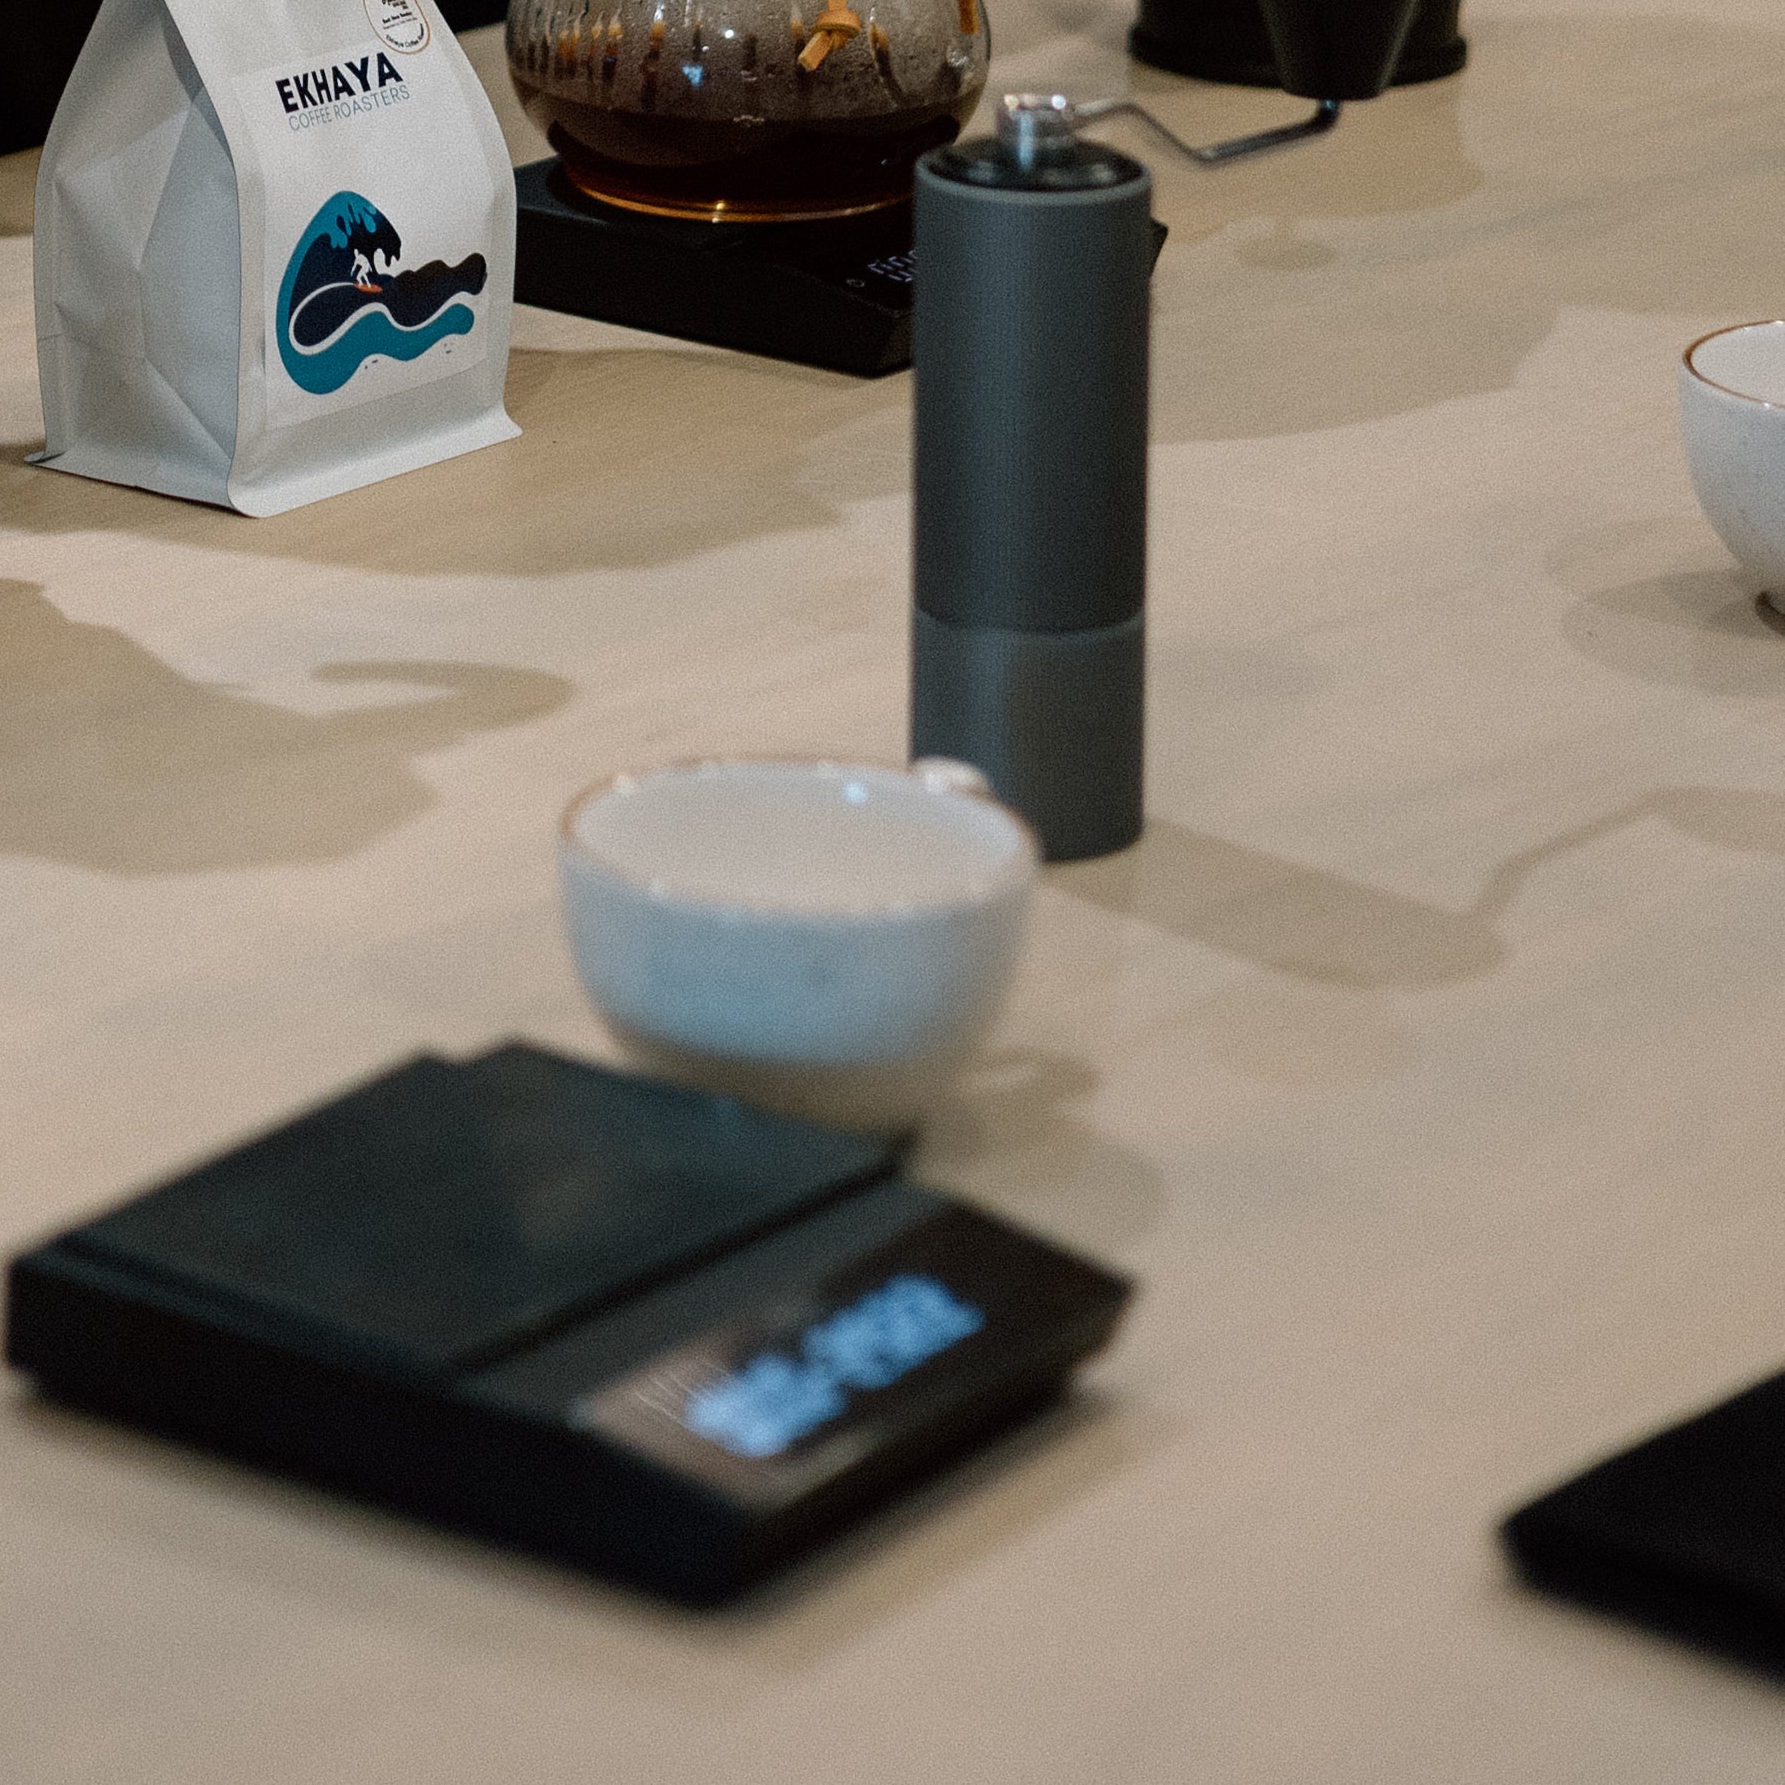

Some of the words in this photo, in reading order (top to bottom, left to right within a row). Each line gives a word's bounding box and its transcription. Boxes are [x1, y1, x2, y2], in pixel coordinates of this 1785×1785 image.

[275, 52, 404, 114] EKHAYA
[288, 106, 333, 131] COFFEE
[333, 84, 411, 122] ROASTERS
